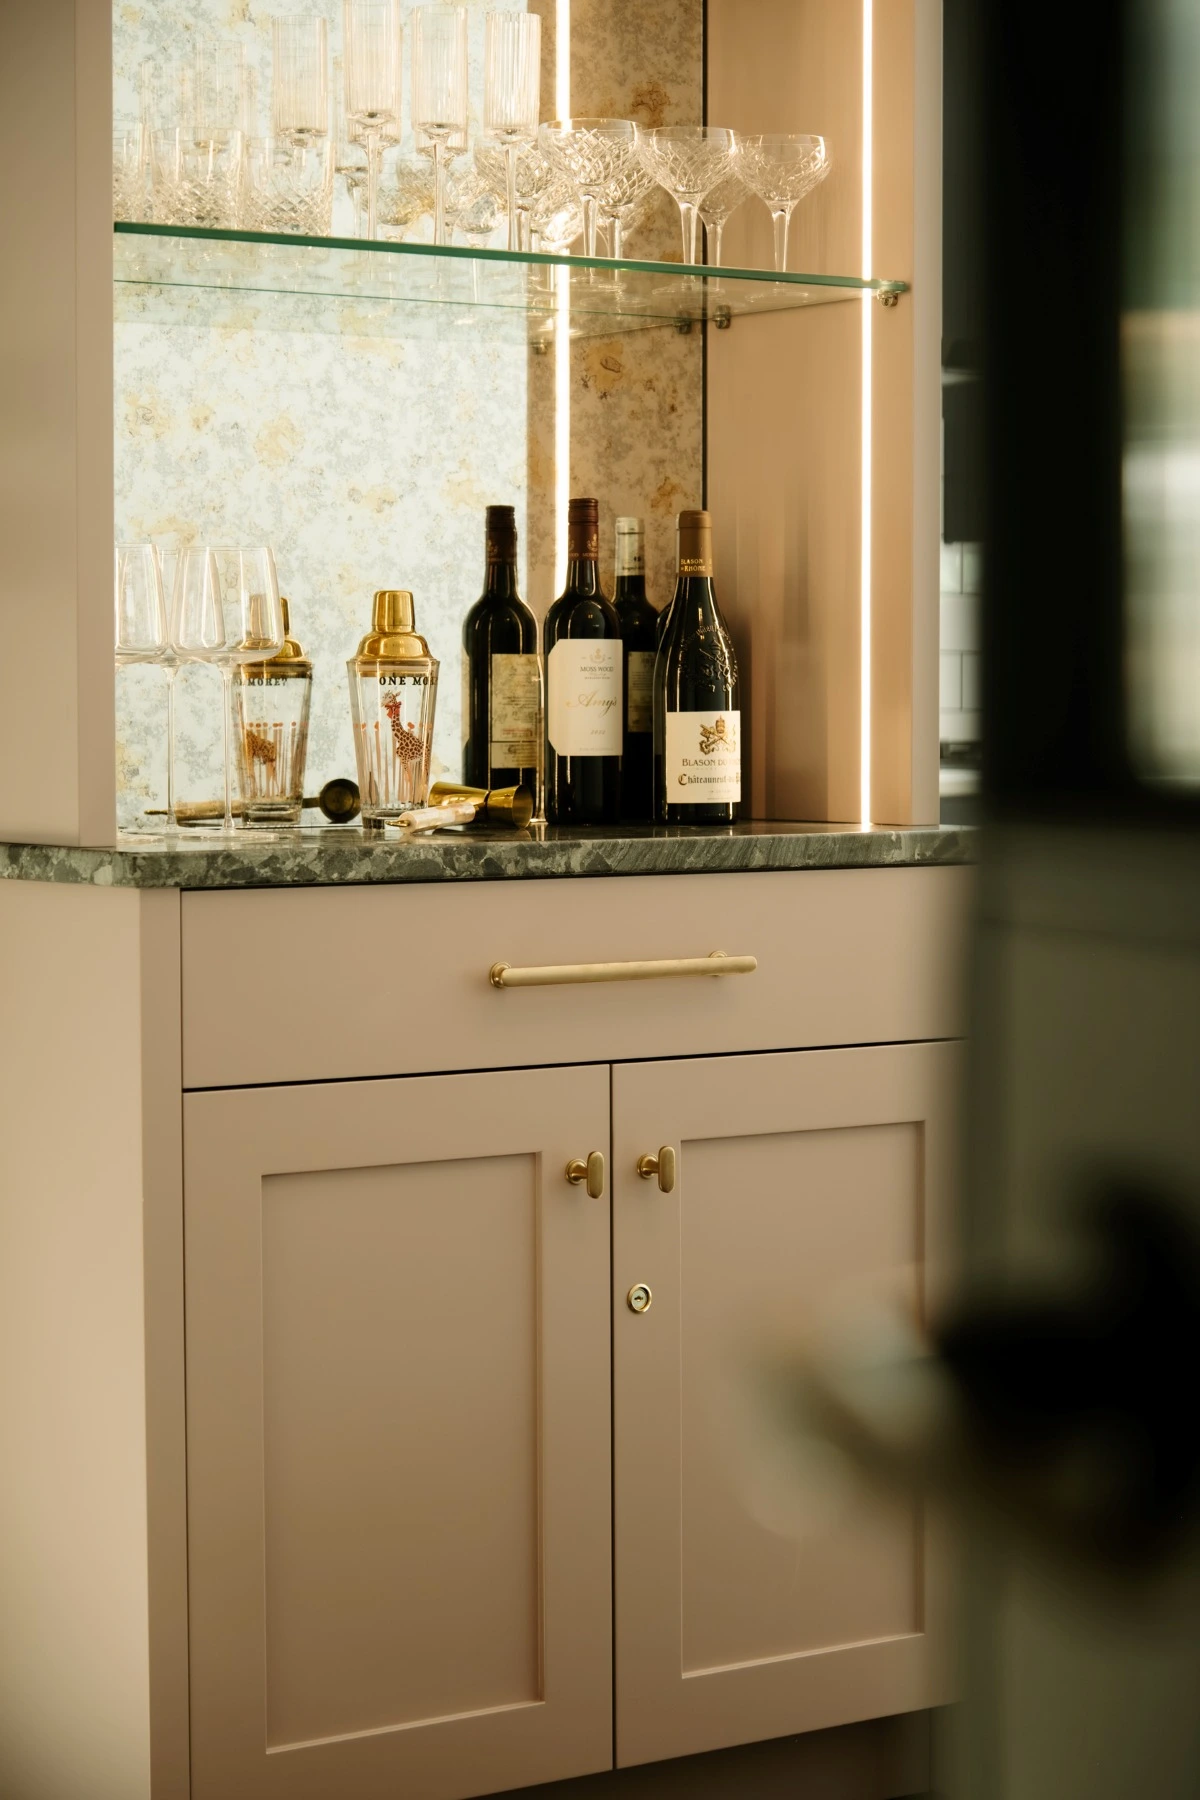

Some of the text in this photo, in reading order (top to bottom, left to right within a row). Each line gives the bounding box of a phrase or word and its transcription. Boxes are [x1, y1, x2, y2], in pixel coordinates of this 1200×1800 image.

[247, 677, 288, 687] MORE?
[379, 676, 406, 686] ONE
[682, 758, 716, 767] BLASON
